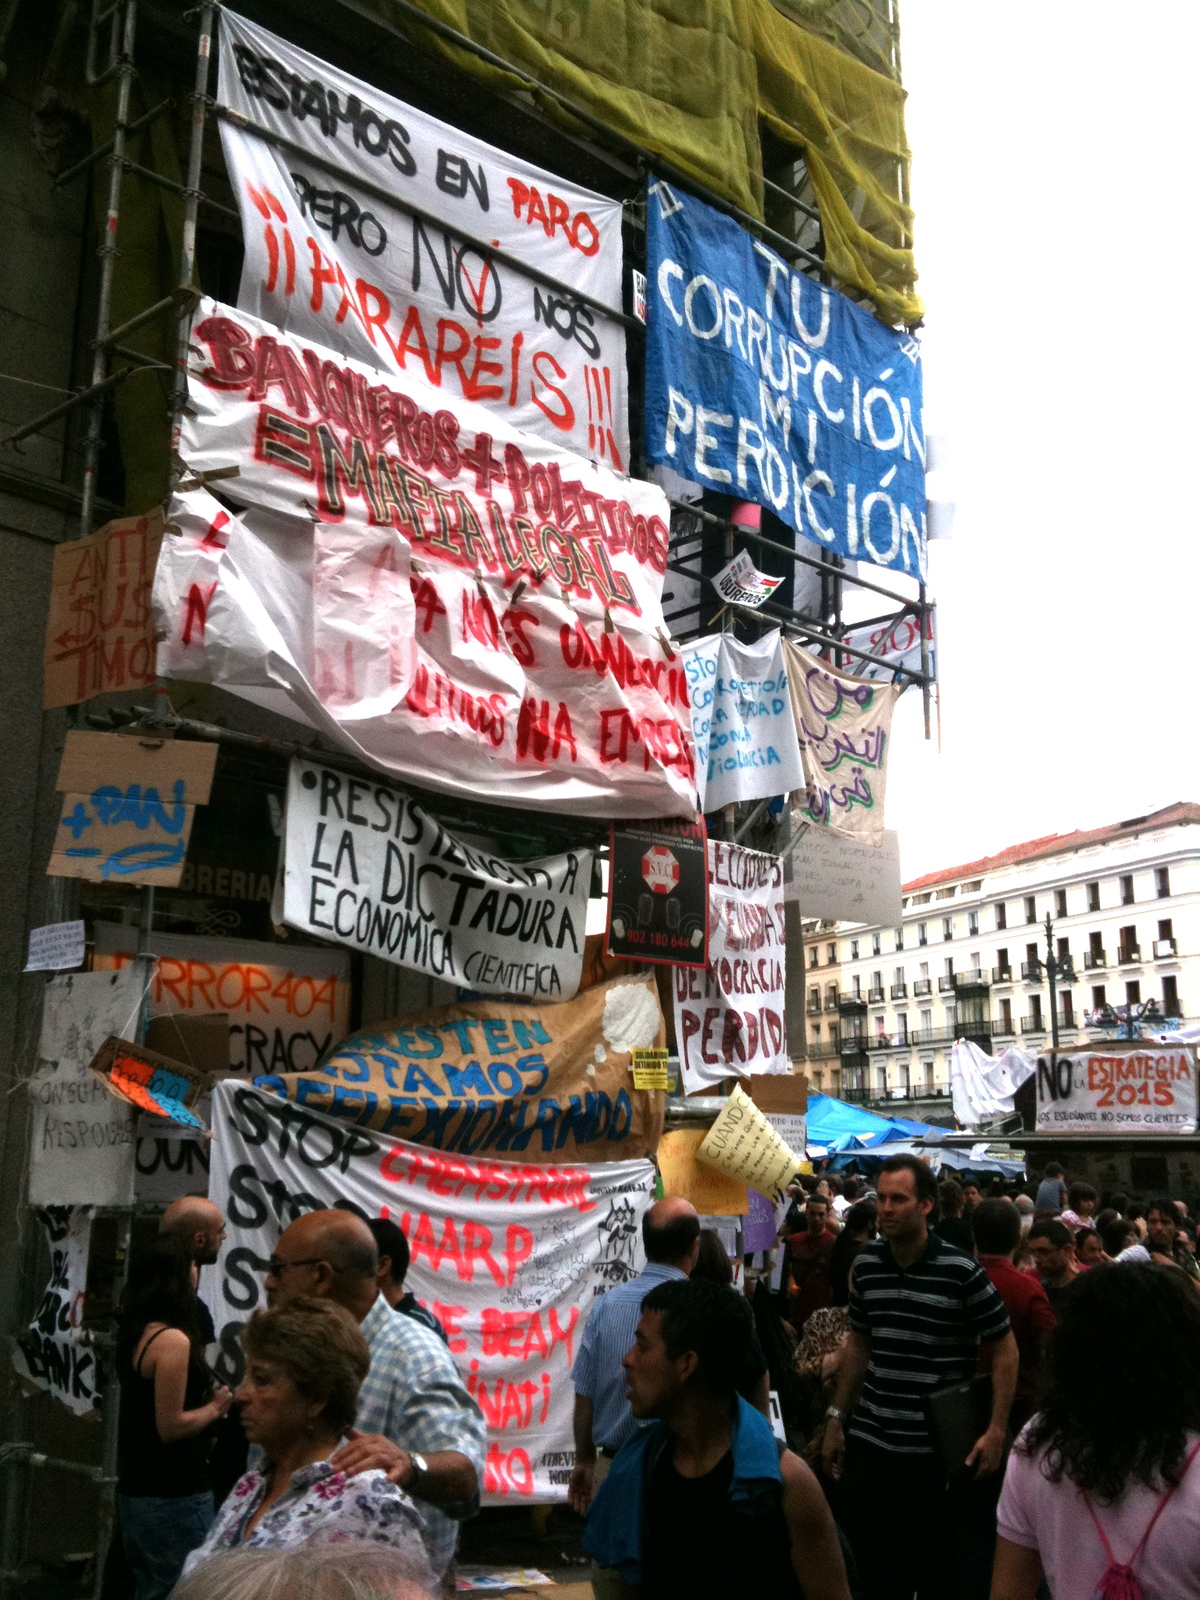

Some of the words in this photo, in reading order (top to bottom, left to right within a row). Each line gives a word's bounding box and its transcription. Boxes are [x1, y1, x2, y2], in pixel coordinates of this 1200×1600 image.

[232, 43, 417, 177] ESTAMOS
[436, 148, 489, 212] EN
[507, 177, 600, 257] PARO
[291, 173, 386, 256] PERO
[412, 215, 502, 321] NO
[533, 287, 601, 359] NOS
[753, 240, 830, 348] TU
[193, 315, 461, 477] BANQUEROS
[657, 258, 925, 467] CORRUPCIÓN
[760, 381, 817, 464] MI
[665, 385, 927, 586] PERDICIÓN
[489, 497, 645, 618] LEGAL
[182, 863, 271, 901] BRERIA
[308, 875, 455, 978] ECONOMICA
[463, 950, 562, 997] CIENTIFICA
[310, 822, 359, 885] LA
[382, 839, 579, 954] DICTADURA
[113, 952, 271, 1014] RROR
[229, 1024, 333, 1074] CRACY
[1038, 1058, 1073, 1101] NO
[1088, 1055, 1191, 1091] ESTRATEGIA
[1097, 1082, 1174, 1107] 2015
[228, 1088, 381, 1175] STOP
[1101, 1111, 1114, 1122] NO
